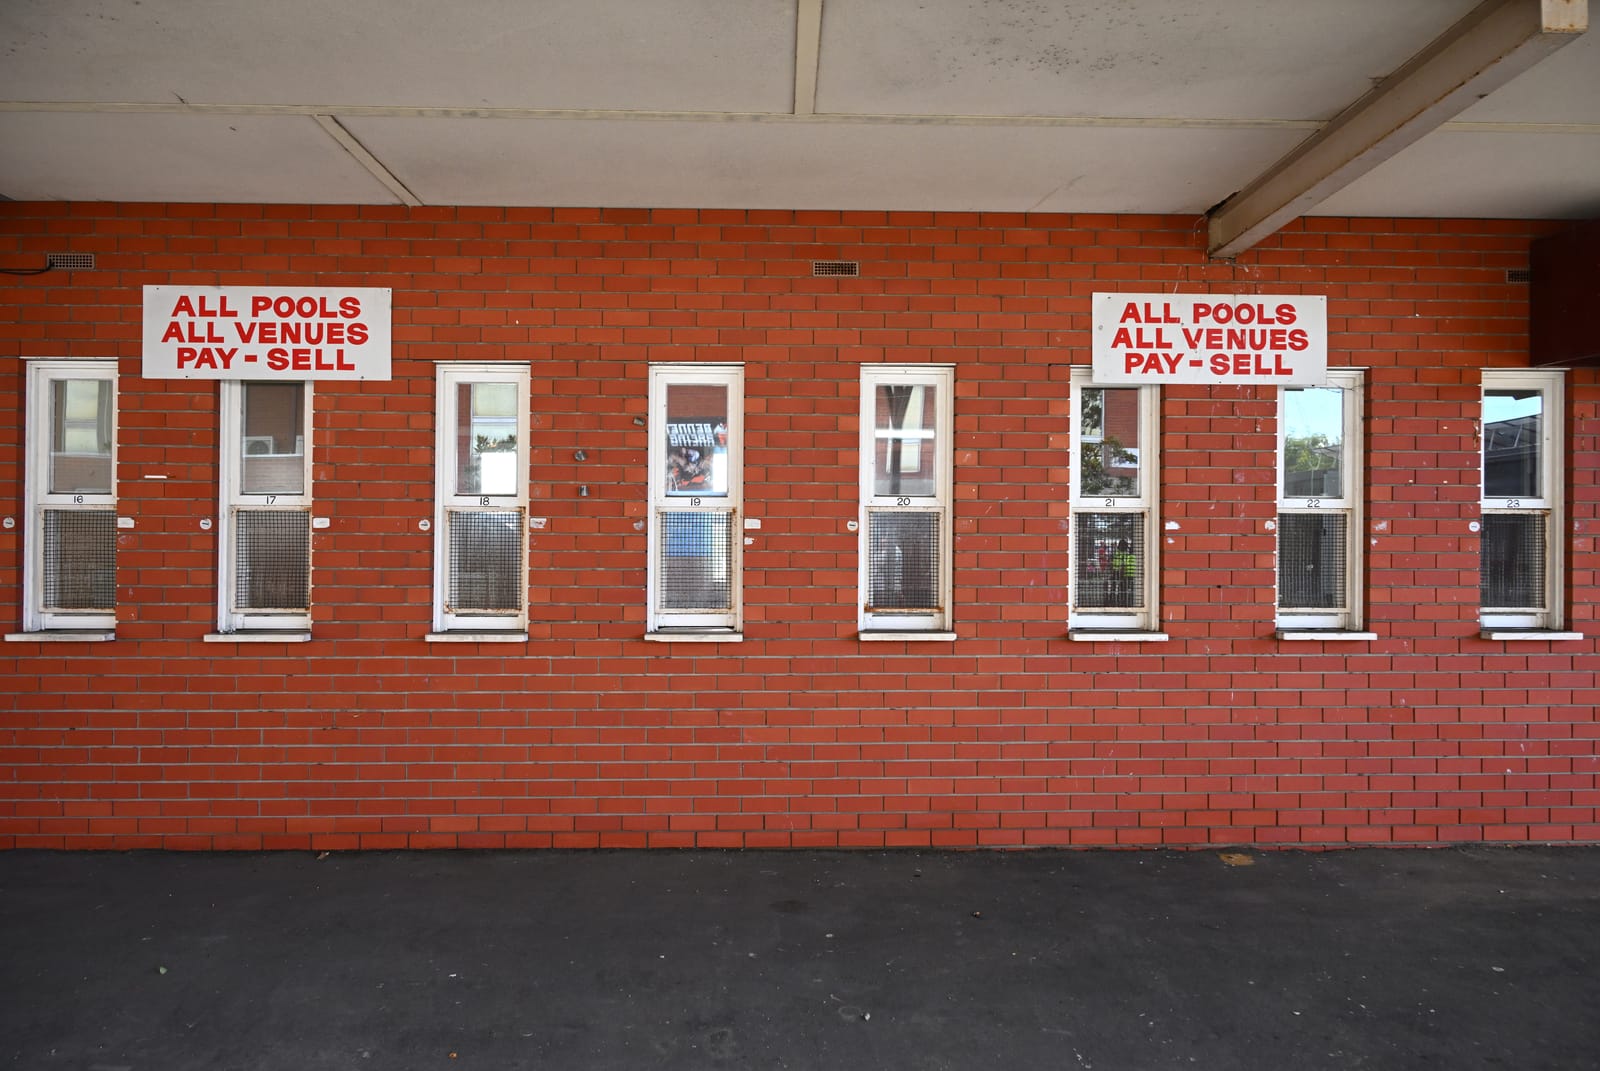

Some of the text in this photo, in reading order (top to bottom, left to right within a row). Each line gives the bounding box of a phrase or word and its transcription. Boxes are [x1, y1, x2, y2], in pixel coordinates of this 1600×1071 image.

[172, 295, 361, 319] ALL POOLS
[1120, 302, 1297, 325] ALL POOLS
[162, 321, 368, 345] ALL VENUES
[1112, 327, 1309, 351] ALL VENUES
[177, 348, 238, 369] PAY
[267, 348, 355, 371] SELL
[1125, 353, 1184, 374] PAY
[1210, 353, 1293, 376] SELL
[73, 495, 84, 504] 16
[266, 495, 276, 505] 17
[479, 496, 490, 506] 18
[690, 497, 701, 506] 19
[897, 497, 911, 506] 20
[1105, 498, 1116, 507] 21
[1307, 499, 1320, 508] 22
[1506, 499, 1520, 508] 23
